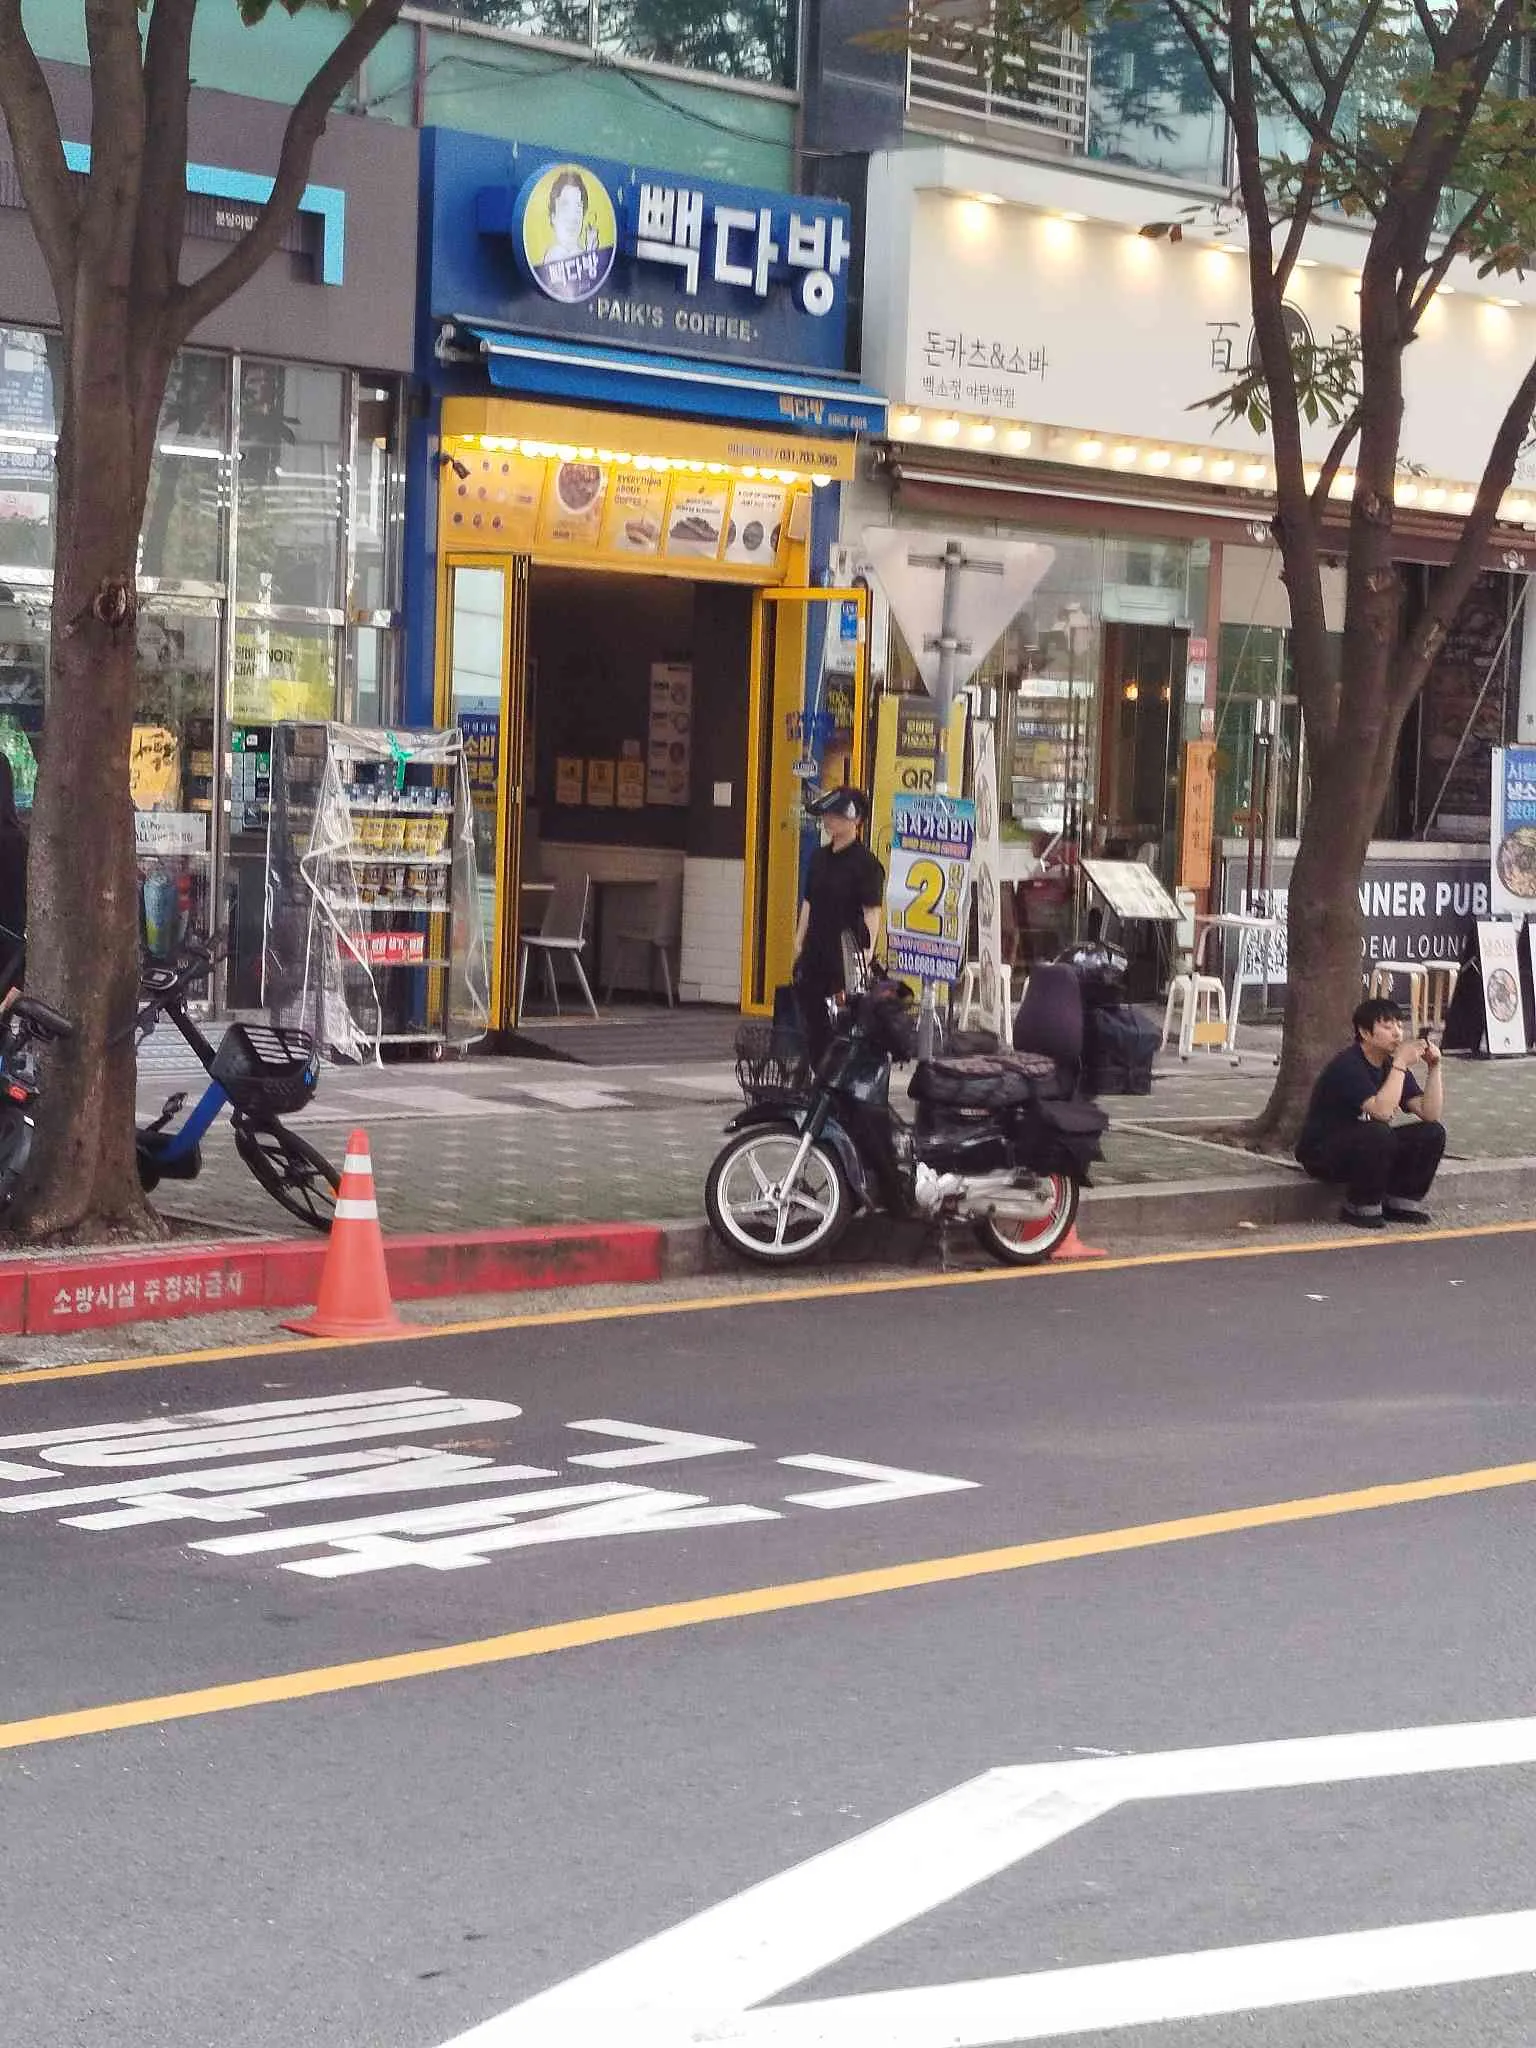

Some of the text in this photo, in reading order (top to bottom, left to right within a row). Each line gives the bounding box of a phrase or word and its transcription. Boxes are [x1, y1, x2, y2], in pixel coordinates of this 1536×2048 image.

[549, 251, 600, 288] 빽다방
[636, 183, 851, 317] 빽다방
[597, 297, 751, 342] PAIK'S COFFEE
[921, 330, 1049, 382] 돈카츠&소바
[901, 768, 933, 791] QR
[904, 858, 945, 937] 2
[1436, 882, 1488, 917] PUB
[1406, 935, 1467, 959] LOUN
[52, 1270, 243, 1315] 소방시설 주정차금지
